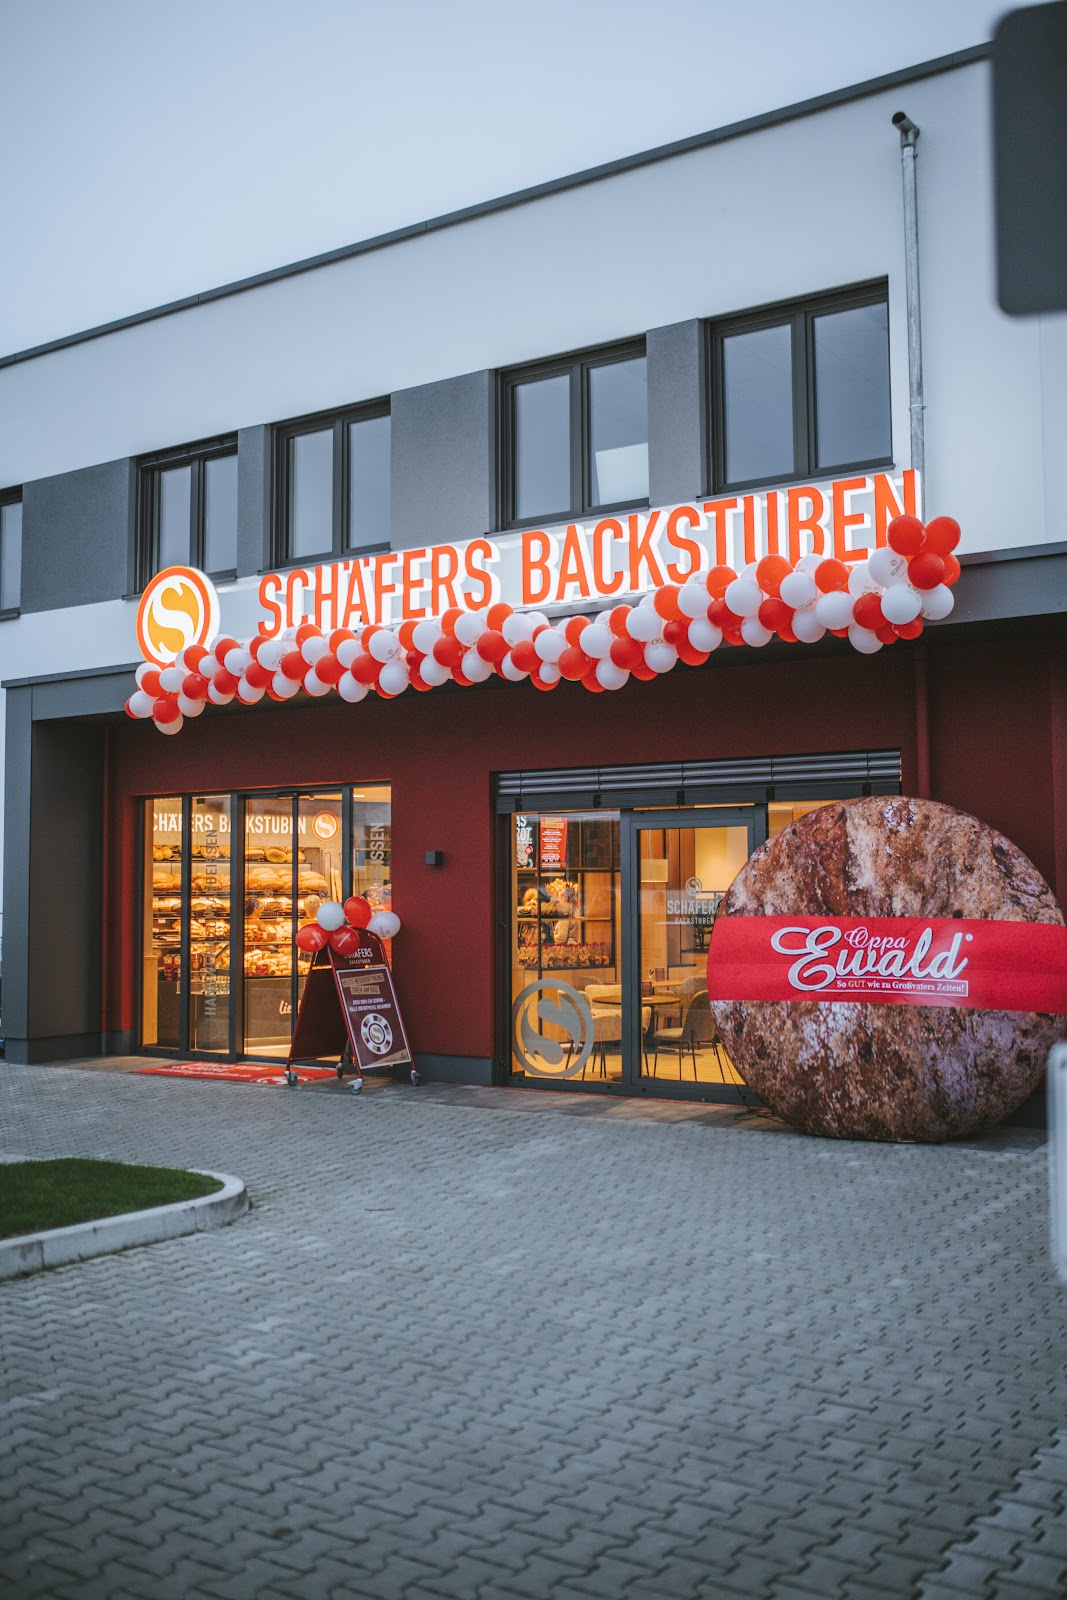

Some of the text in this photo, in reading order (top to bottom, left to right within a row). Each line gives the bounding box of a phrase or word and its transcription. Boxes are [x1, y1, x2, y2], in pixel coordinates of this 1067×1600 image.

[257, 468, 919, 639] SCHÄFERS BACKSTUBEN
[770, 925, 969, 991] Ewald
[844, 926, 910, 956] Oppa
[836, 979, 847, 988] So
[848, 980, 866, 989] GUT
[867, 980, 880, 989] wie
[892, 980, 935, 991] Großvaters
[936, 983, 965, 992] Zeiten!
